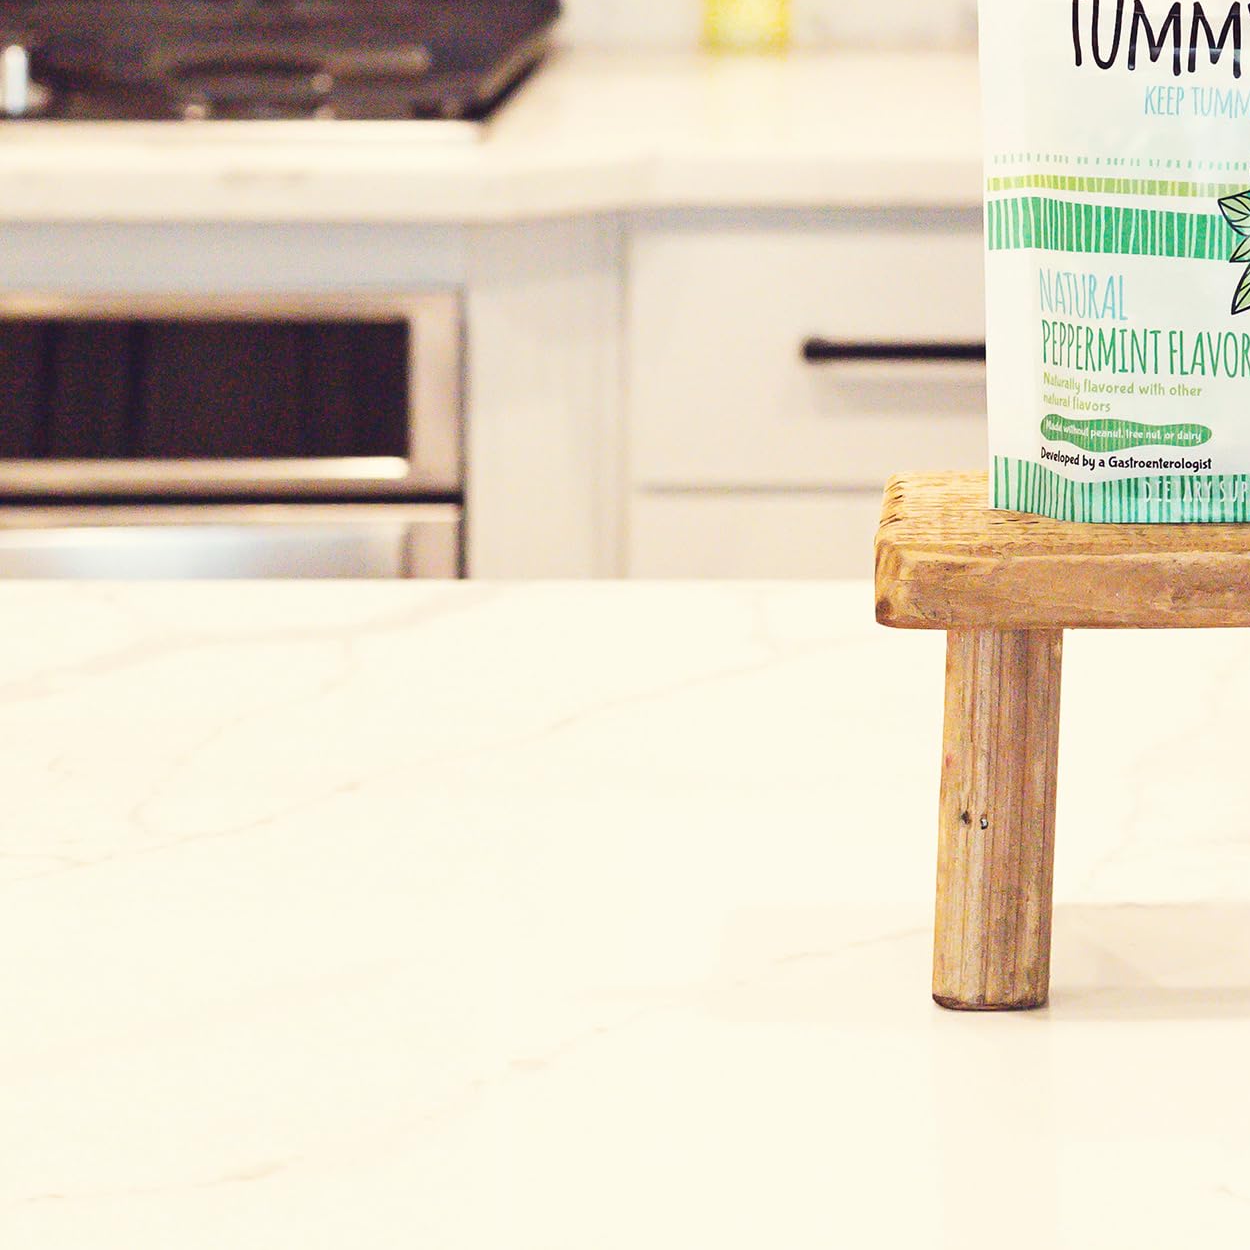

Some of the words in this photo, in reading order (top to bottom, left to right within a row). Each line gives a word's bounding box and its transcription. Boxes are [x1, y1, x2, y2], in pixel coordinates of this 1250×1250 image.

[1144, 85, 1184, 116] KEEP
[1039, 268, 1128, 321] NATURAL
[1041, 319, 1161, 375] PEPPERMINT
[1043, 372, 1081, 395] Naturally
[1083, 380, 1134, 395] flavored
[1138, 383, 1166, 396] with
[1169, 385, 1203, 397] other
[1043, 393, 1070, 408] natural
[1072, 395, 1112, 413] flavors
[1164, 431, 1175, 440] or
[1177, 430, 1203, 444] dairy
[1040, 446, 1080, 467] Developed
[1082, 455, 1096, 470] by
[1098, 459, 1105, 467] a
[1108, 455, 1212, 473] Gastroenterologist
[1144, 480, 1213, 503] DIEARY
